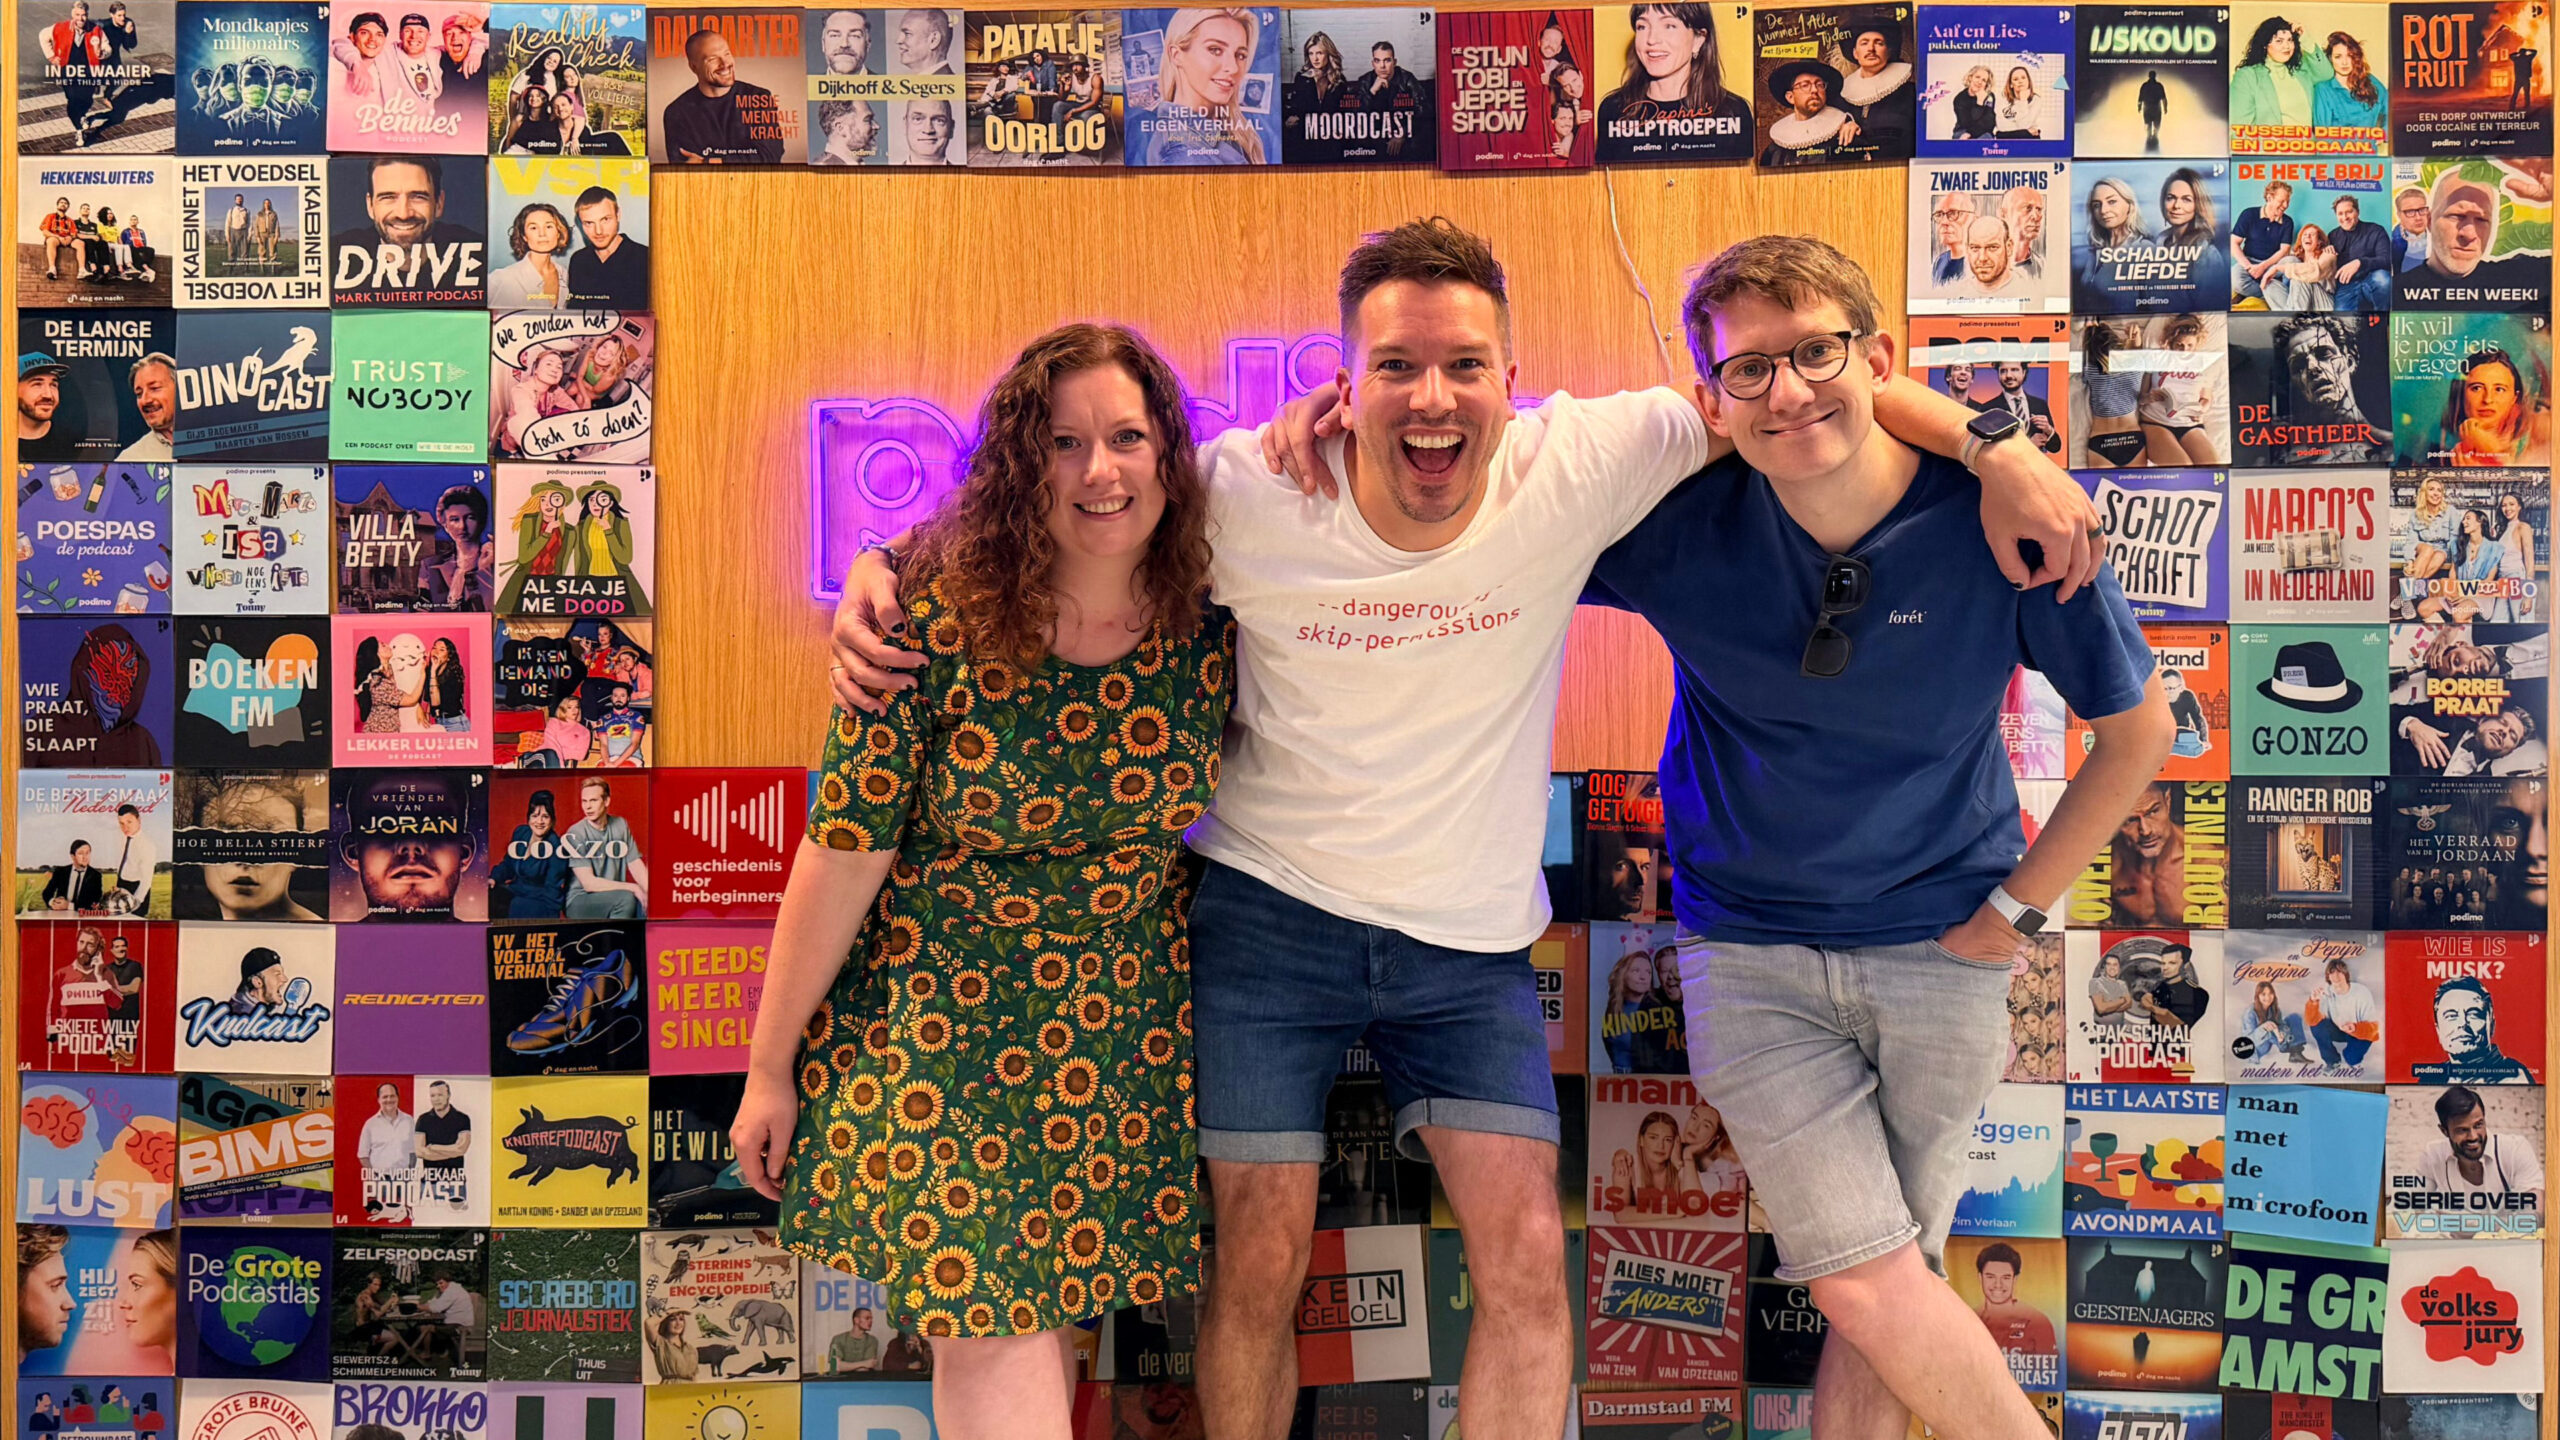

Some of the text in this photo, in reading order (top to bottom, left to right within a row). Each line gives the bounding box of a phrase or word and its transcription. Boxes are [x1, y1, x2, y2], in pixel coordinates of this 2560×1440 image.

[203, 18, 309, 35] Mondkapjes
[1929, 25, 2026, 38] Aaf en Lies
[213, 35, 300, 51] miljonairs
[984, 23, 1104, 61] PATATJE
[1928, 41, 2000, 52] pakken door
[2090, 25, 2216, 53] IJSKOUD
[2403, 14, 2474, 60] ROT
[1463, 46, 1528, 68] STIJN
[45, 64, 151, 77] IN DE WAAIER
[1452, 68, 1508, 89] TOBI
[2404, 60, 2468, 88] FRUIT
[818, 79, 956, 97] Dijkhoff & Segers
[736, 94, 779, 107] MISSIE
[1452, 89, 1526, 111] JEPPE
[742, 110, 799, 123] MENTALE
[1169, 106, 1230, 118] HELD IN
[2419, 111, 2526, 121] EEN DORP ONTWRICHT
[1141, 119, 1263, 132] EIGEN VERHAAL
[1305, 111, 1415, 140] MOORDCAST
[1452, 111, 1527, 134] SHOW
[1608, 118, 1740, 137] HULPTROEPEN
[2406, 121, 2540, 132] DOOR COCAÏNE EN TERREUR
[750, 126, 799, 140] KRACHT
[985, 113, 1105, 153] OORLOG
[2232, 125, 2384, 140] TUSSEN DERTIG
[215, 138, 243, 147] podimo
[1344, 147, 1376, 157] podimo
[2232, 140, 2258, 152] EN
[41, 171, 154, 185] HEKKENSLUITERS
[183, 164, 320, 182] HET VOEDSEL
[1931, 171, 2048, 190] ZWARE JONGENS
[2239, 163, 2384, 181] DE HETE BRIJ
[183, 187, 200, 278] KABINET
[305, 185, 321, 276] KABINET
[2100, 246, 2200, 263] SCHADUW
[334, 243, 482, 289] DRIVE
[2115, 263, 2187, 279] LIEFDE
[335, 290, 484, 303] MARK TUITERT PODCAST
[2404, 288, 2538, 300] WAT EEN WEEK!
[45, 321, 152, 337] DE LANGE
[2394, 316, 2452, 335] Ik wil
[53, 340, 144, 357] TERMIJN
[2393, 336, 2498, 357] je nog iets
[352, 360, 444, 382] TRUST
[2393, 357, 2470, 376] vragen
[347, 387, 472, 411] NOBODY
[2238, 405, 2270, 422] DE
[2238, 424, 2383, 446] GASTHEER
[2245, 487, 2374, 540] NARCO'S
[37, 520, 156, 539] POESPAS
[349, 513, 416, 540] VILLA
[56, 541, 135, 560] de podcast
[344, 540, 422, 567] BETTY
[523, 580, 626, 596] AL SLA JE
[2245, 569, 2374, 600] IN NEDERLAND
[523, 598, 625, 614] ME DOOD
[189, 658, 318, 689] BOEKEN
[26, 684, 59, 696] WIE
[2427, 678, 2511, 697] BORREL
[26, 701, 89, 716] PRAAT,
[231, 696, 274, 726] FM
[2434, 697, 2503, 716] PRAAT
[26, 719, 54, 732] DIE
[26, 738, 98, 751] SLAAPT
[2252, 725, 2368, 755] GONZO
[2248, 787, 2372, 813] RANGER ROB
[177, 838, 326, 848] HOE BELLA STIERF
[508, 834, 629, 860] co&zo
[673, 859, 782, 874] geschiedenis
[673, 876, 712, 887] voor
[672, 890, 784, 904] herbeginners
[2072, 1088, 2219, 1110] HET LAATSTE
[2237, 1094, 2299, 1115] man
[504, 1128, 622, 1155] KNORREPODCAST
[2234, 1129, 2288, 1147] met
[2231, 1157, 2263, 1178] de
[2393, 1176, 2426, 1188] EEN
[26, 1177, 167, 1219] LUST
[2393, 1191, 2537, 1210] SERIE OVER
[2226, 1193, 2369, 1224] microfoon
[2070, 1213, 2216, 1236] AVONDMAAL
[2393, 1213, 2537, 1234] VOEDING
[343, 1248, 477, 1261] ZELFSPODCAST
[189, 1253, 322, 1278] De Grote
[688, 1259, 752, 1270] STERRINS
[695, 1271, 744, 1283] DIEREN
[1614, 1259, 1724, 1295] ALLES MOET
[189, 1279, 320, 1304] Podcastlas
[500, 1280, 636, 1309] SCOREBORD
[669, 1283, 771, 1297] ENCYCLOPEDIE
[1302, 1276, 1395, 1306] KEIN
[2420, 1285, 2439, 1299] de
[1616, 1286, 1709, 1315] ANDERS
[2420, 1294, 2498, 1317] volks
[500, 1308, 633, 1332] JOURNALISTIEK
[1302, 1303, 1398, 1338] GELOEL
[2074, 1302, 2215, 1327] GEESTENJAGERS
[2464, 1319, 2522, 1350] jury
[333, 1367, 437, 1377] SCHIMMELPENNINCK
[577, 1357, 607, 1368] THUIS
[576, 1370, 592, 1379] UIT
[1588, 1396, 1732, 1416] Darmstad FM
